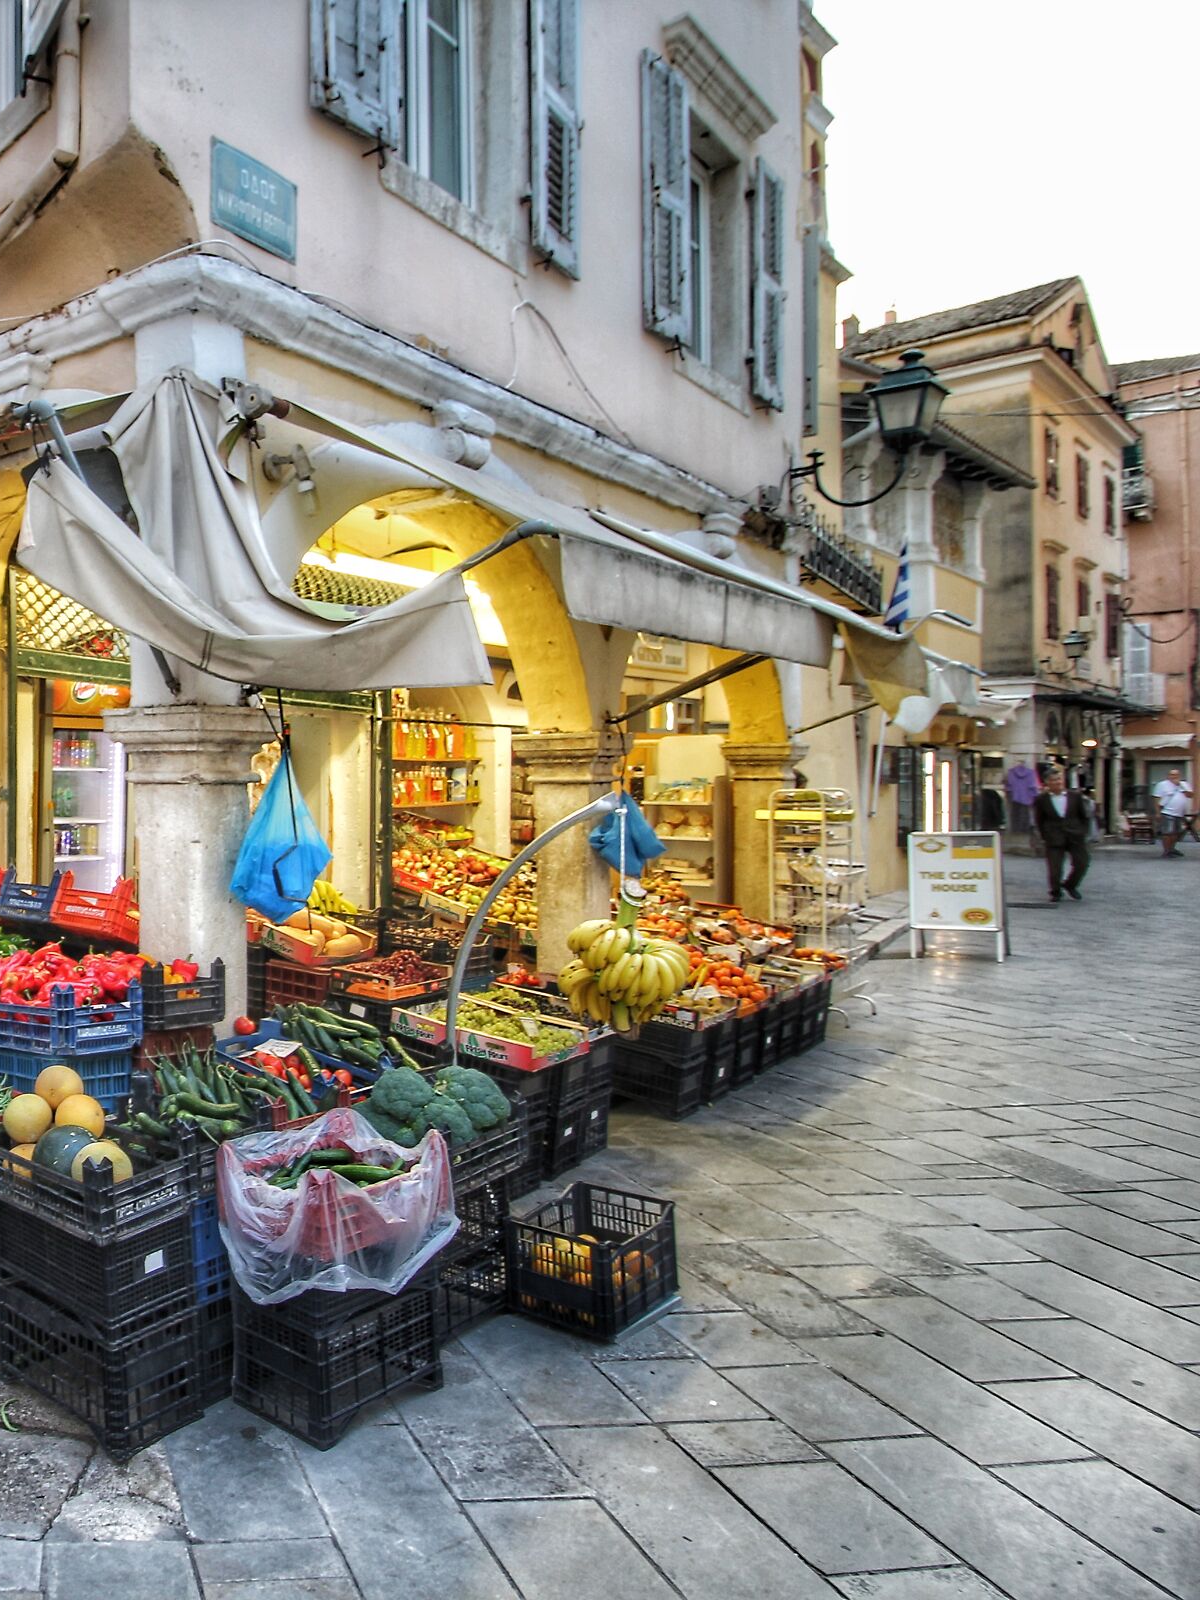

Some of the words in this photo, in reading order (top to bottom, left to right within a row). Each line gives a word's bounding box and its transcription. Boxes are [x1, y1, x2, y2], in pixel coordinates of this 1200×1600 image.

[241, 169, 276, 205] ΟΔΟΣ
[919, 871, 945, 880] THE
[949, 871, 989, 880] CIGAR
[931, 883, 977, 893] HOUSE
